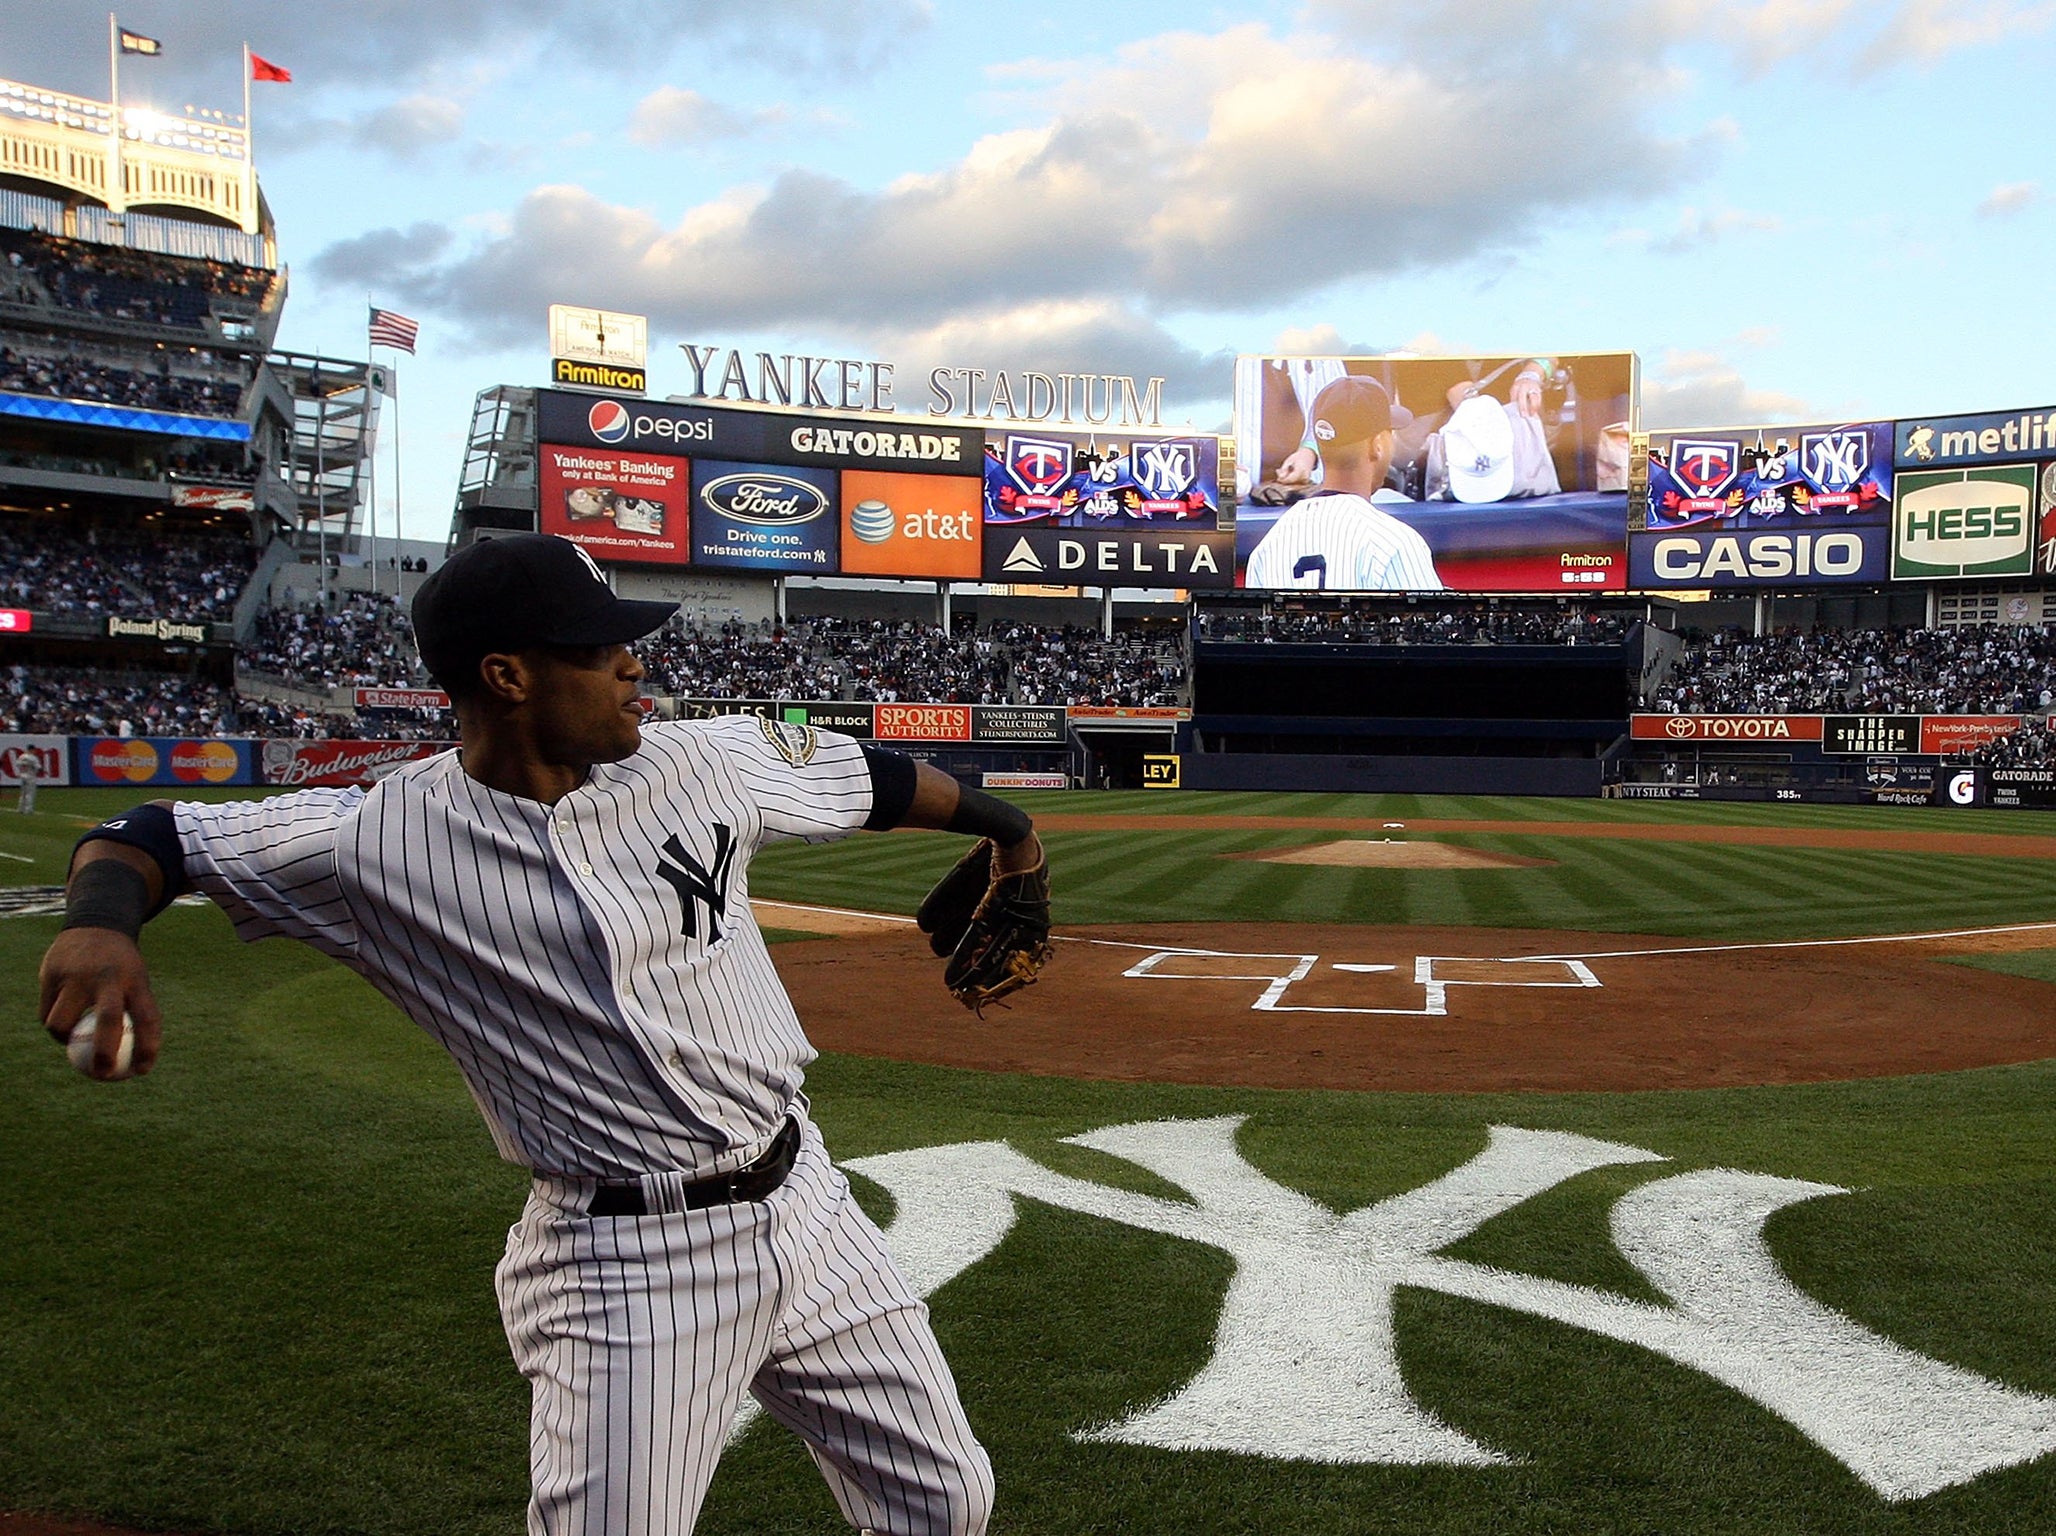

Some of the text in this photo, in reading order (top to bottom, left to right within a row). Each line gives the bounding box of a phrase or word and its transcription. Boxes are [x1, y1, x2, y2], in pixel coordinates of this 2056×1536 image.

[557, 360, 645, 390] Armitron
[679, 343, 1165, 426] YANKEE STADIUM
[634, 415, 713, 442] pepsi
[790, 427, 960, 461] GATORADE
[620, 459, 674, 479] Banking
[562, 470, 666, 486] only at Bank of America
[730, 483, 800, 515] Ford
[903, 508, 974, 540] at&t
[1907, 505, 2021, 541] HESS
[727, 529, 803, 546] Drive one.
[703, 544, 811, 560] tristateford.com
[1059, 539, 1219, 573] DELTA
[1560, 553, 1612, 566] Armitron
[1653, 533, 1863, 579] CASIO
[109, 616, 205, 642] Poland Spring
[380, 693, 440, 705] State Farm
[810, 715, 868, 726] H&R BLOCK
[879, 708, 965, 726] SPORTS
[989, 720, 1048, 729] COLLECTIBLES
[1858, 718, 1884, 729] THE
[979, 730, 1057, 739] STEINERSPORTS.COM
[1700, 719, 1790, 737] TOYOTA
[1837, 729, 1904, 740] SHARPER
[1848, 740, 1894, 751] IMAGE
[92, 754, 157, 767] MasterCard
[171, 755, 237, 768] MasterCard
[280, 742, 420, 785] Budweiser
[1025, 779, 1063, 787] DONUTS
[1992, 770, 2054, 782] GATORADE
[1643, 788, 1671, 798] STEAK
[1877, 793, 1927, 805] Hard Rock Cafe
